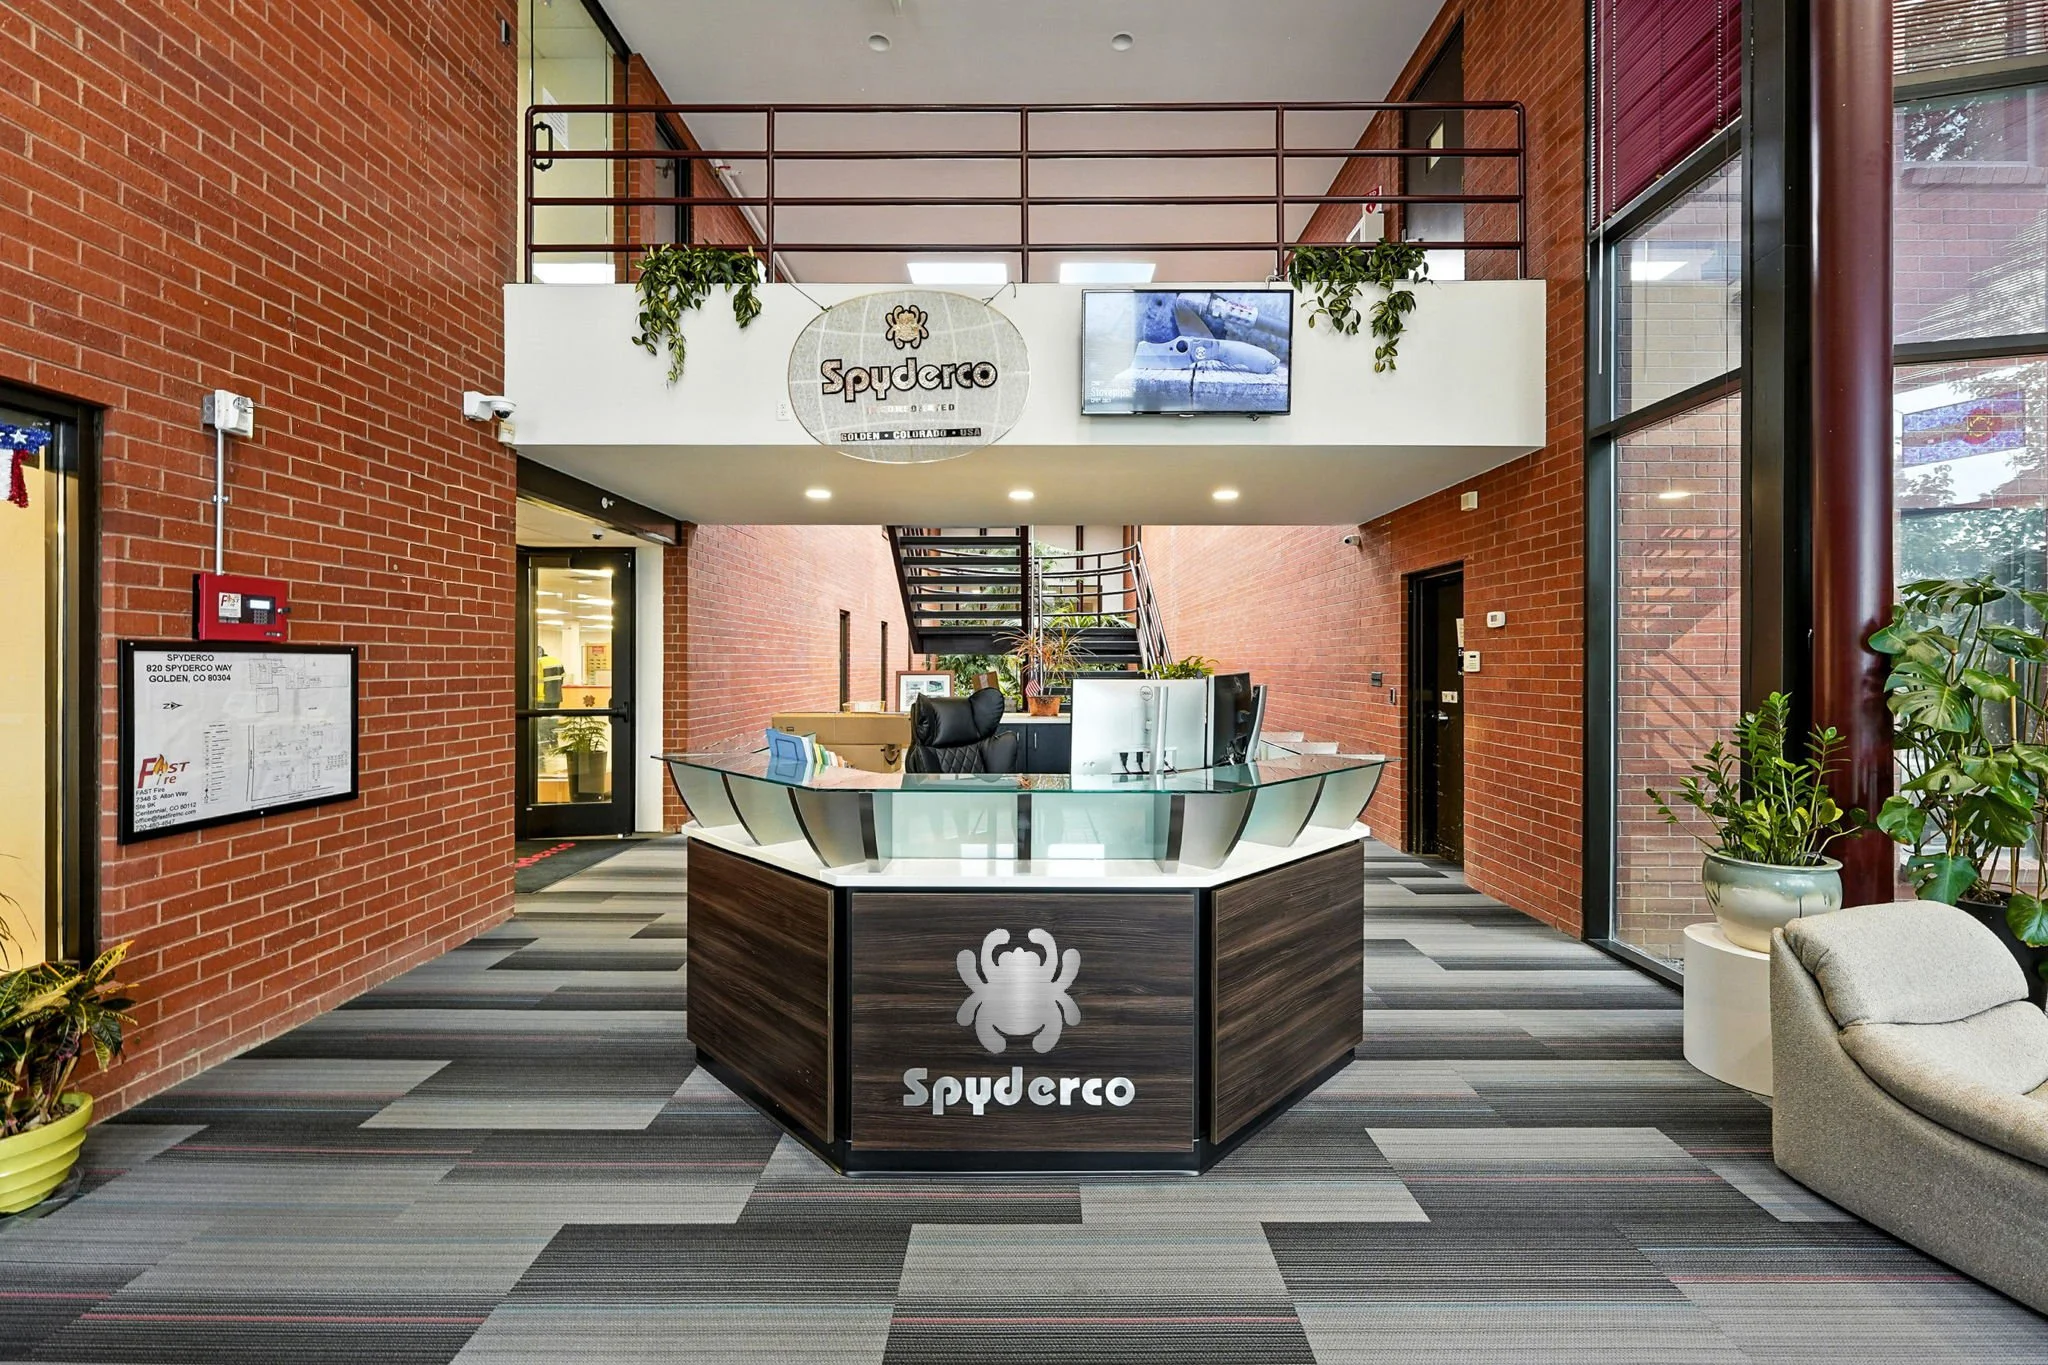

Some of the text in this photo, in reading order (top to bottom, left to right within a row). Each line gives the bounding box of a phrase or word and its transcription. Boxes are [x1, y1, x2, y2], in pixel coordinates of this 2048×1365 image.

[821, 357, 998, 402] Spyderco
[841, 428, 981, 442] GOLDEN COLORADO USA
[167, 653, 214, 662] SPYDERCO
[146, 664, 233, 672] 820 SPYDERCO WAY
[148, 674, 231, 683] GOLDEN, CO 80304
[902, 1066, 1136, 1116] Spyderco
